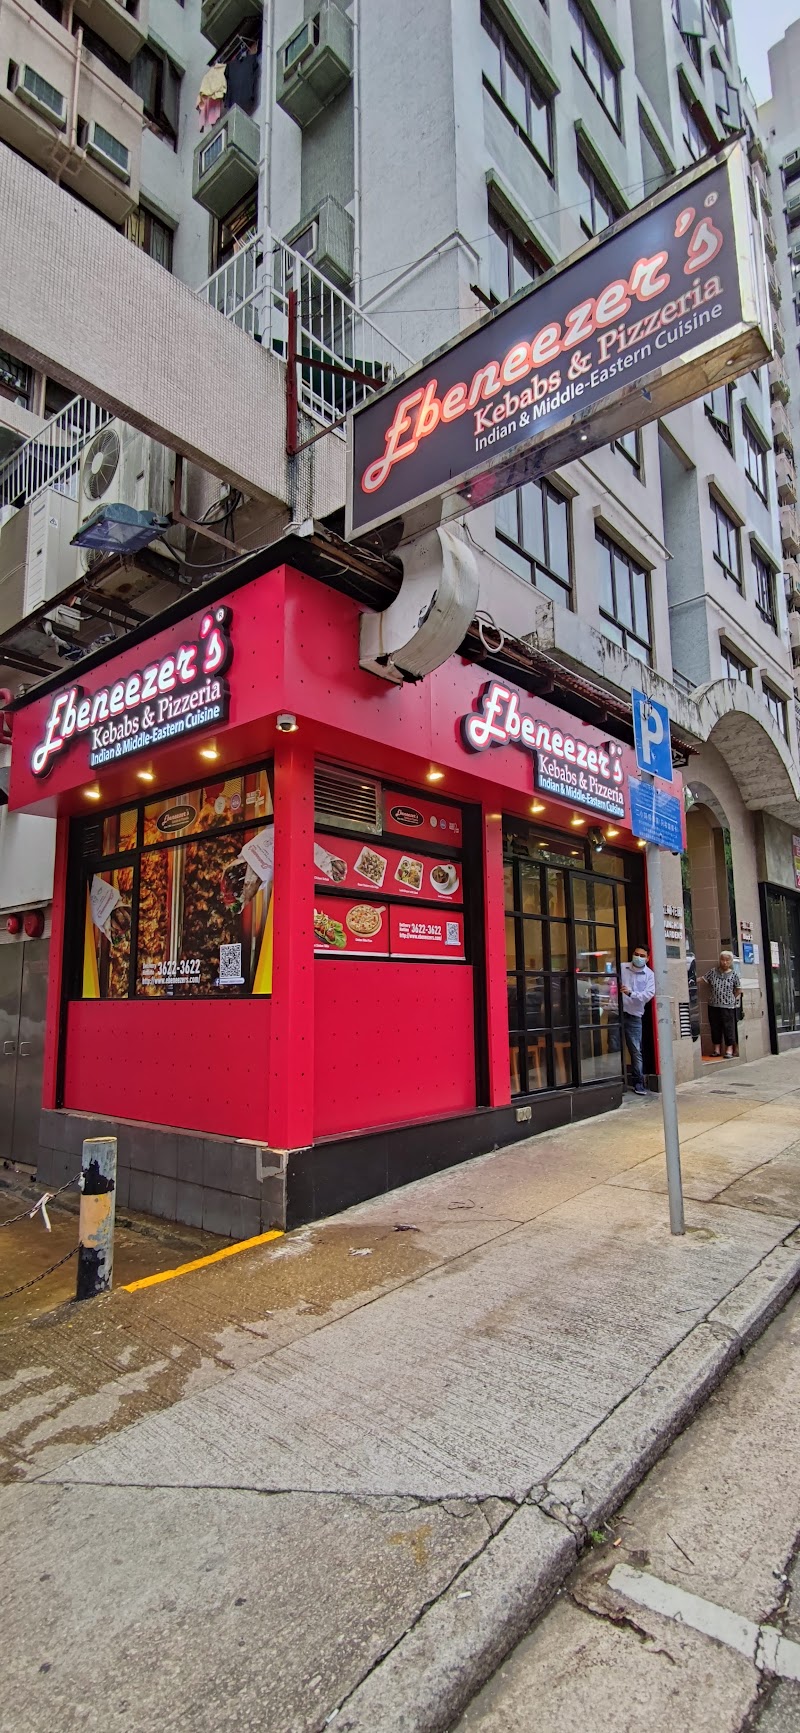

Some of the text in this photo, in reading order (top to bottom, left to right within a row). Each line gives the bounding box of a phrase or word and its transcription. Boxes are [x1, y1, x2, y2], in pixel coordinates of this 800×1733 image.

[361, 207, 723, 494] Ebeneezer's
[473, 275, 723, 436] Kebabs & Pizzeria
[475, 303, 723, 452] Indian & Middle-Eastern Cuisine
[31, 614, 224, 776] Ebeneezer's
[92, 678, 221, 750] Kebabs & Pizzeria
[91, 704, 220, 766] Indian & Middle-Eastern Cuisine
[468, 681, 624, 784] Ebeneezer's
[639, 700, 664, 765] P
[538, 753, 577, 786] Kebabs
[579, 772, 587, 791] &
[588, 773, 624, 805] Pizzeria
[538, 775, 560, 793] Indian
[560, 782, 566, 793] &
[565, 784, 606, 811] Middle-Eastern
[606, 800, 624, 816] Cuisine
[411, 923, 442, 935] 3622-3622
[157, 958, 200, 976] 3622-3622
